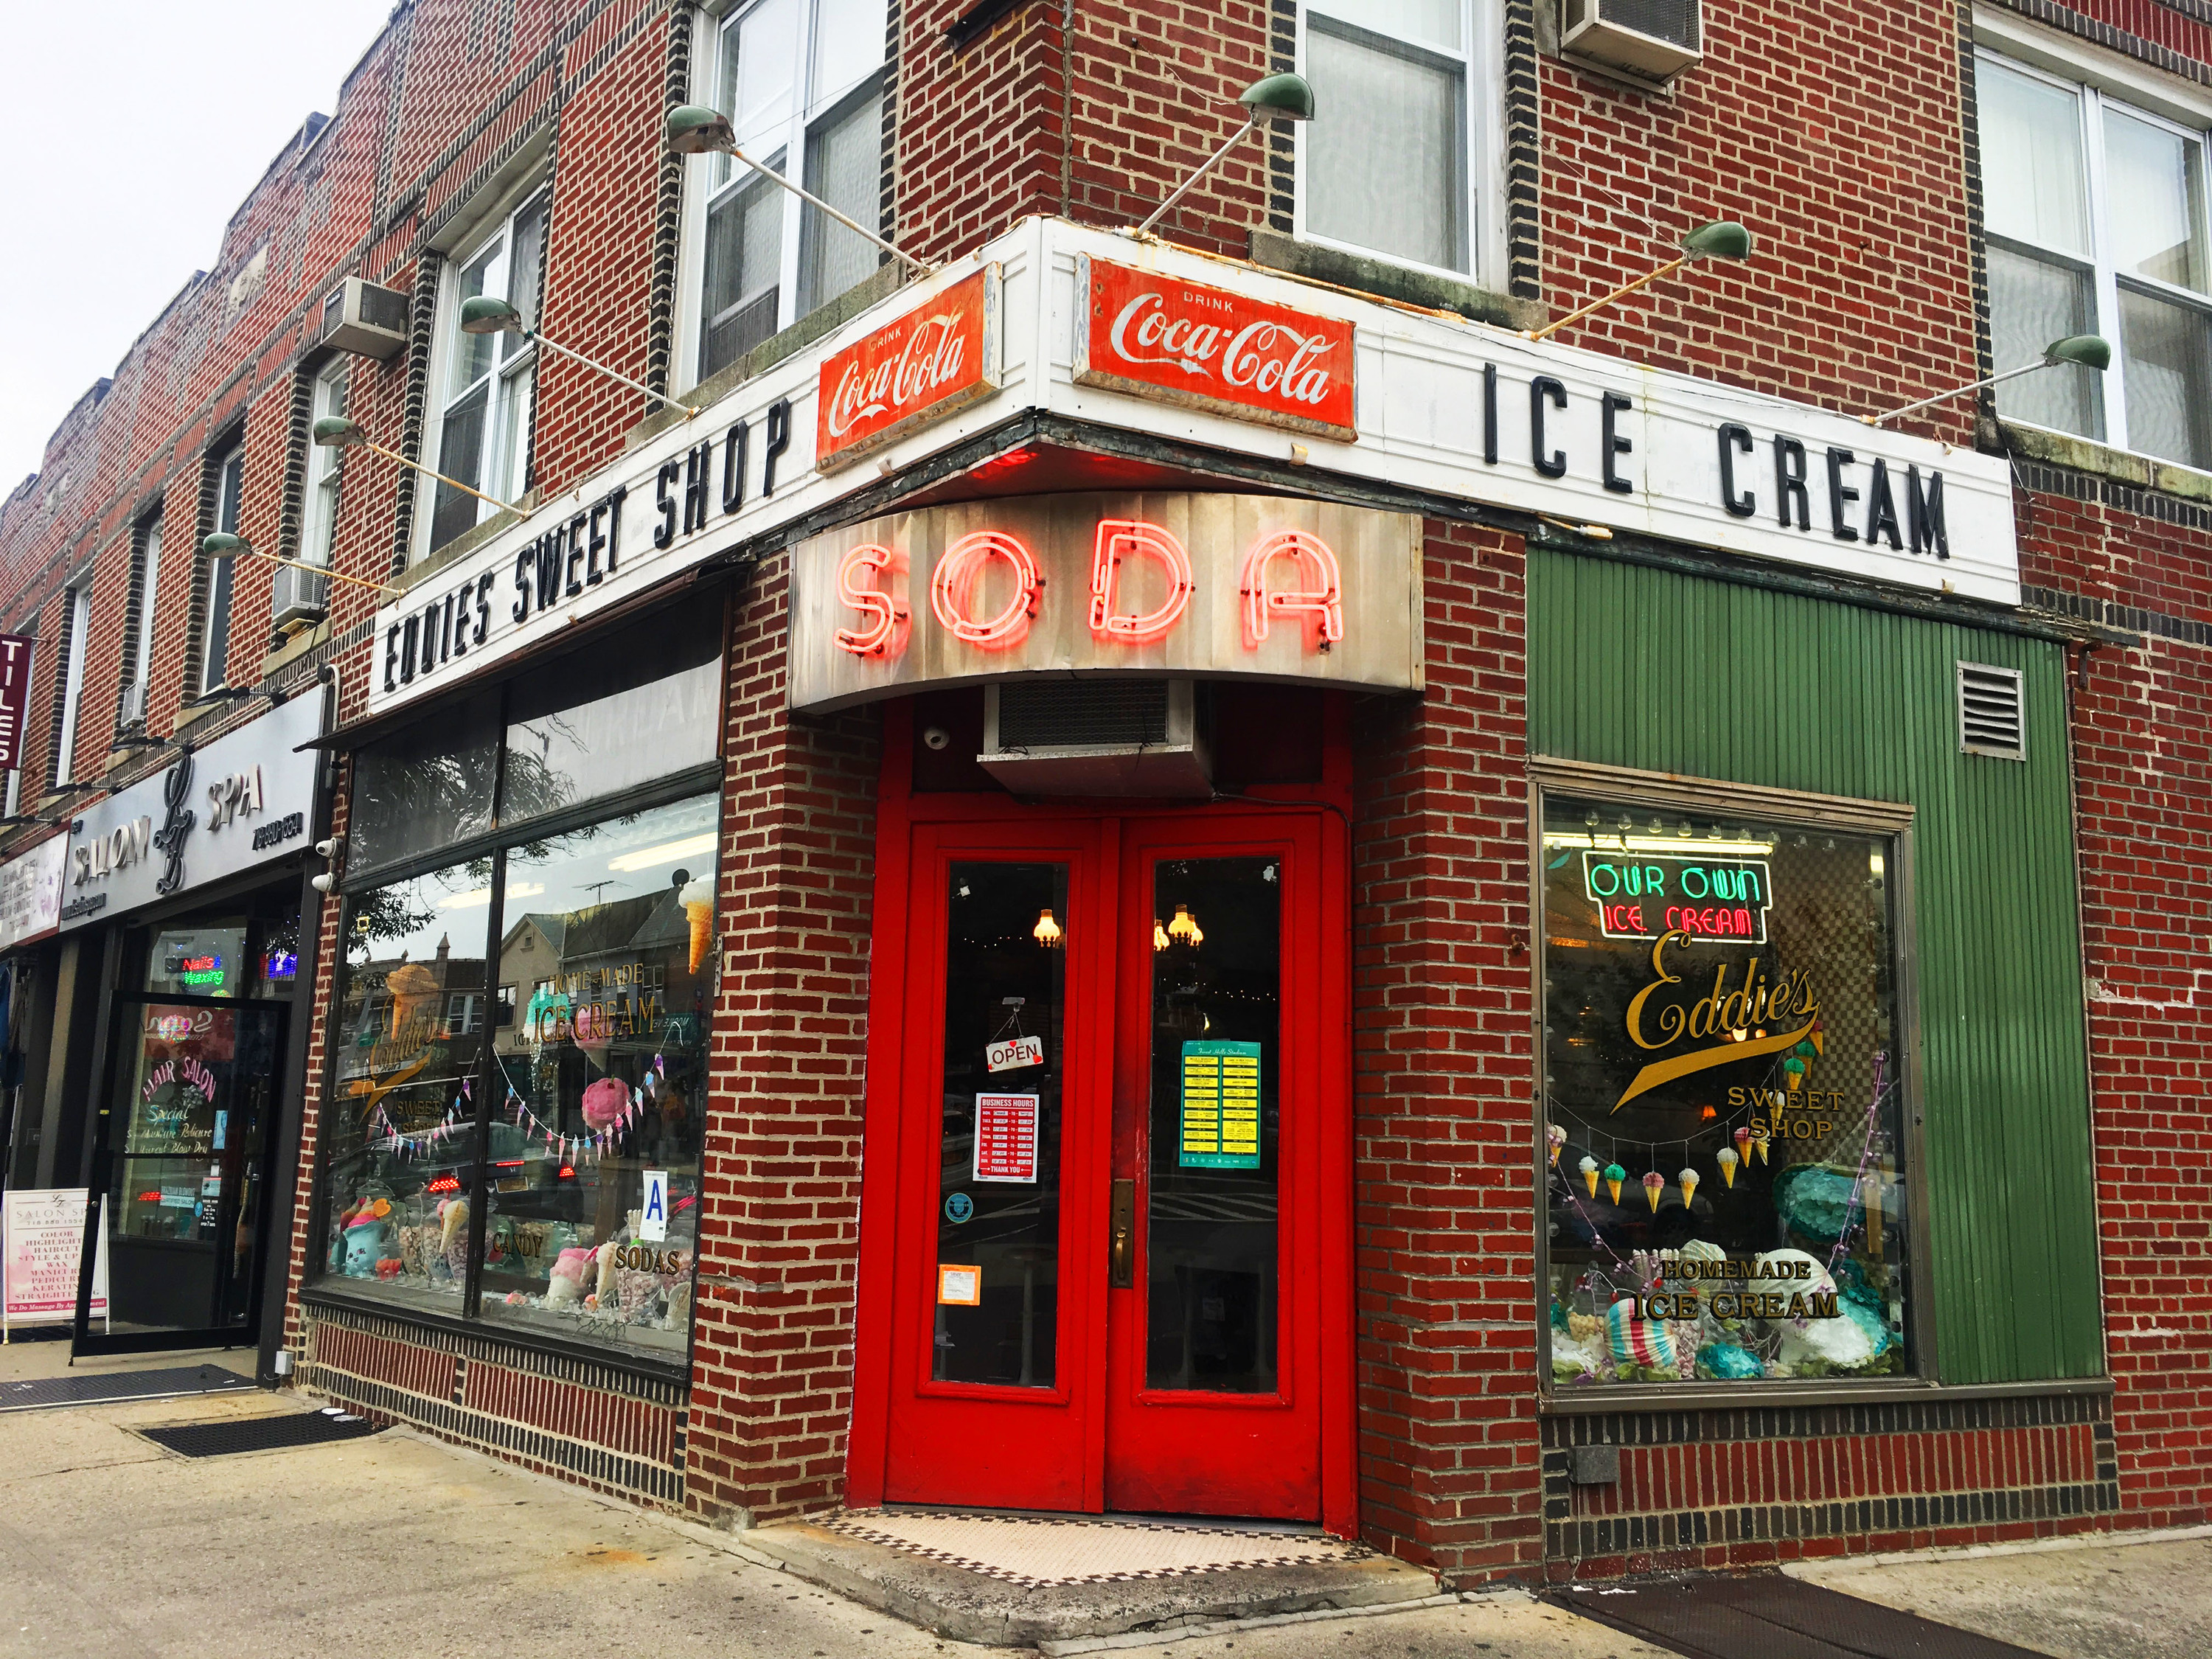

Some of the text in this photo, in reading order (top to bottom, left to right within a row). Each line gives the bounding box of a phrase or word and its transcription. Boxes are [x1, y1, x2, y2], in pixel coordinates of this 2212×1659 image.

[1183, 291, 1233, 313] DRINK
[870, 326, 901, 352] DRINK
[1110, 293, 1338, 404] Coca-Cola
[828, 301, 966, 437] Coca-Cola
[1484, 362, 1950, 560] ICE CREAM
[384, 396, 793, 692] EDDIES SWEET SHOP
[832, 519, 1344, 655] SODA
[72, 815, 150, 886] SALON
[206, 762, 262, 831] SPA
[1590, 864, 1760, 901] OUR OWN
[1605, 905, 1752, 935] ICE CREAM
[182, 956, 214, 971] Nails
[184, 970, 224, 985] Waxing
[1626, 928, 1820, 1050] Eddie's
[533, 995, 655, 1043] ICE CREAM
[992, 1043, 1038, 1065] OPEN
[143, 1055, 217, 1103] HAIR SALON
[396, 1100, 441, 1116] SWEET
[982, 1099, 1034, 1107] BUSINESS HOURS
[1728, 1086, 1844, 1111] SWEET
[148, 1104, 191, 1126] Special
[1749, 1118, 1833, 1141] SHOP
[16, 1208, 87, 1218] SALON SP
[646, 1180, 662, 1221] A
[26, 1237, 83, 1246] HIGHLIGHT
[34, 1245, 80, 1253] HAIRCUT
[493, 1231, 543, 1258] CANDY
[614, 1245, 680, 1276] SODAS
[1661, 1259, 1812, 1280] HOMEMADE
[1632, 1292, 1844, 1321] ICE CREAM
